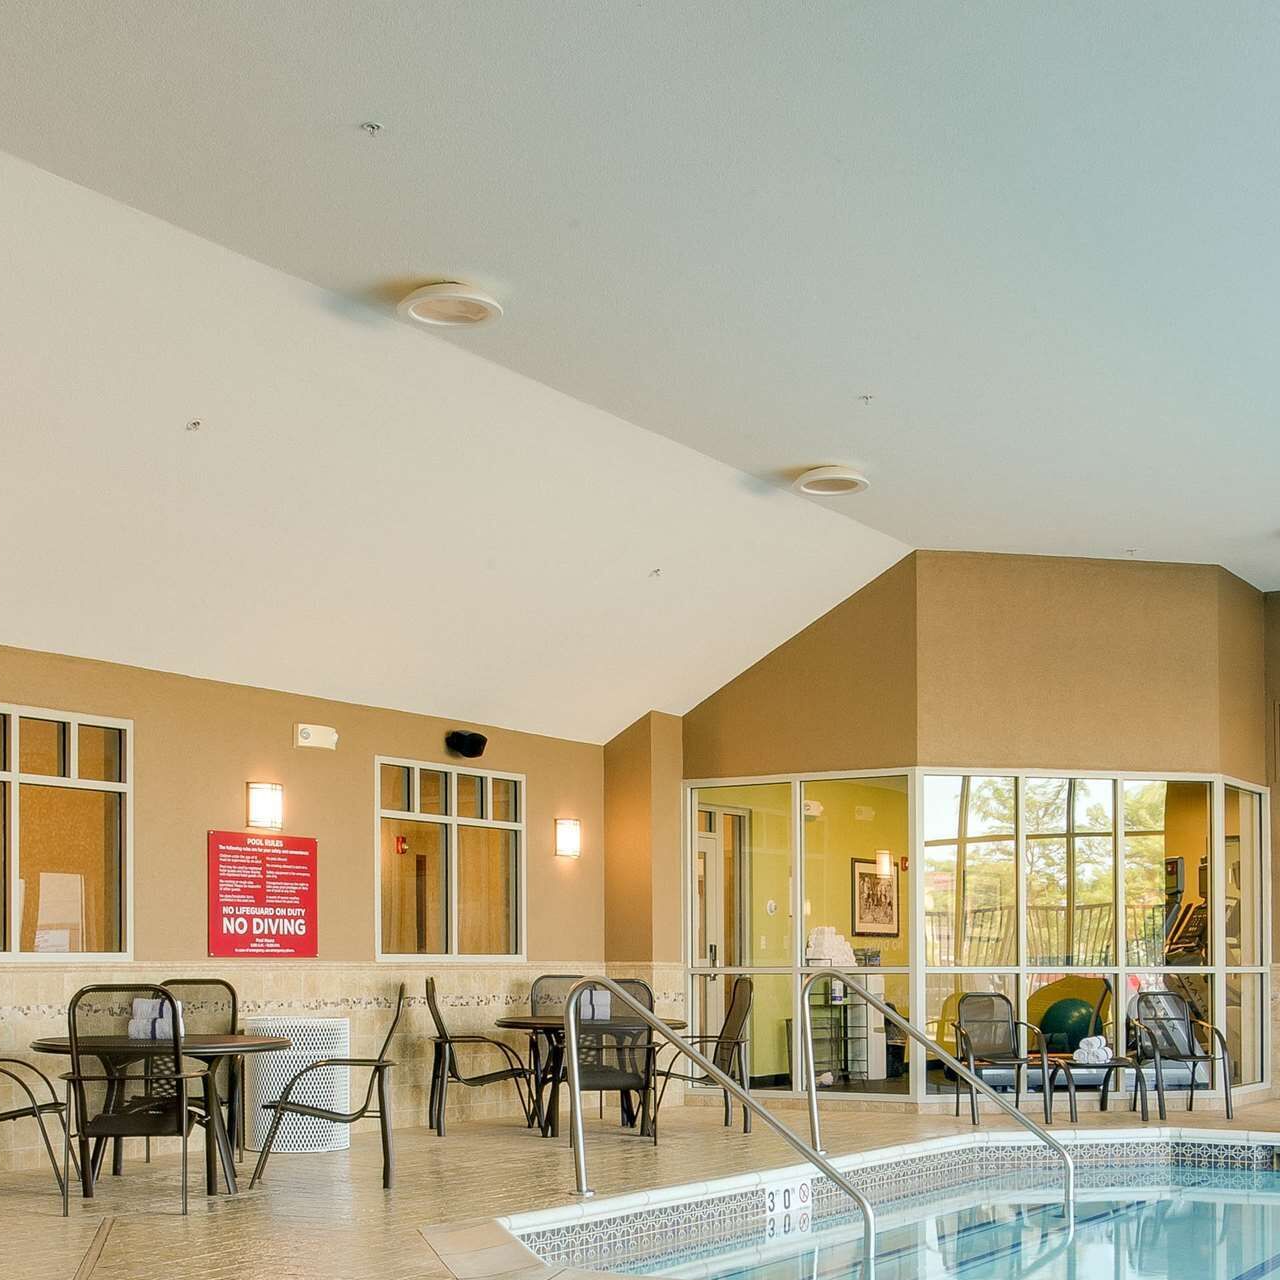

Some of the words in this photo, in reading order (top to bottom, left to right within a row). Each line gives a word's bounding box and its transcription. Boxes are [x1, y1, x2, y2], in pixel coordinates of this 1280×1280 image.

[246, 838, 264, 846] POOL
[264, 839, 284, 847] RULES
[222, 906, 234, 914] NO
[235, 906, 275, 916] LIFEGUARD
[275, 907, 286, 916] ON
[287, 908, 306, 916] DUTY
[222, 917, 248, 934] NO
[252, 917, 306, 935] DIVING
[768, 1191, 775, 1212] 3
[783, 1188, 790, 1209] 0
